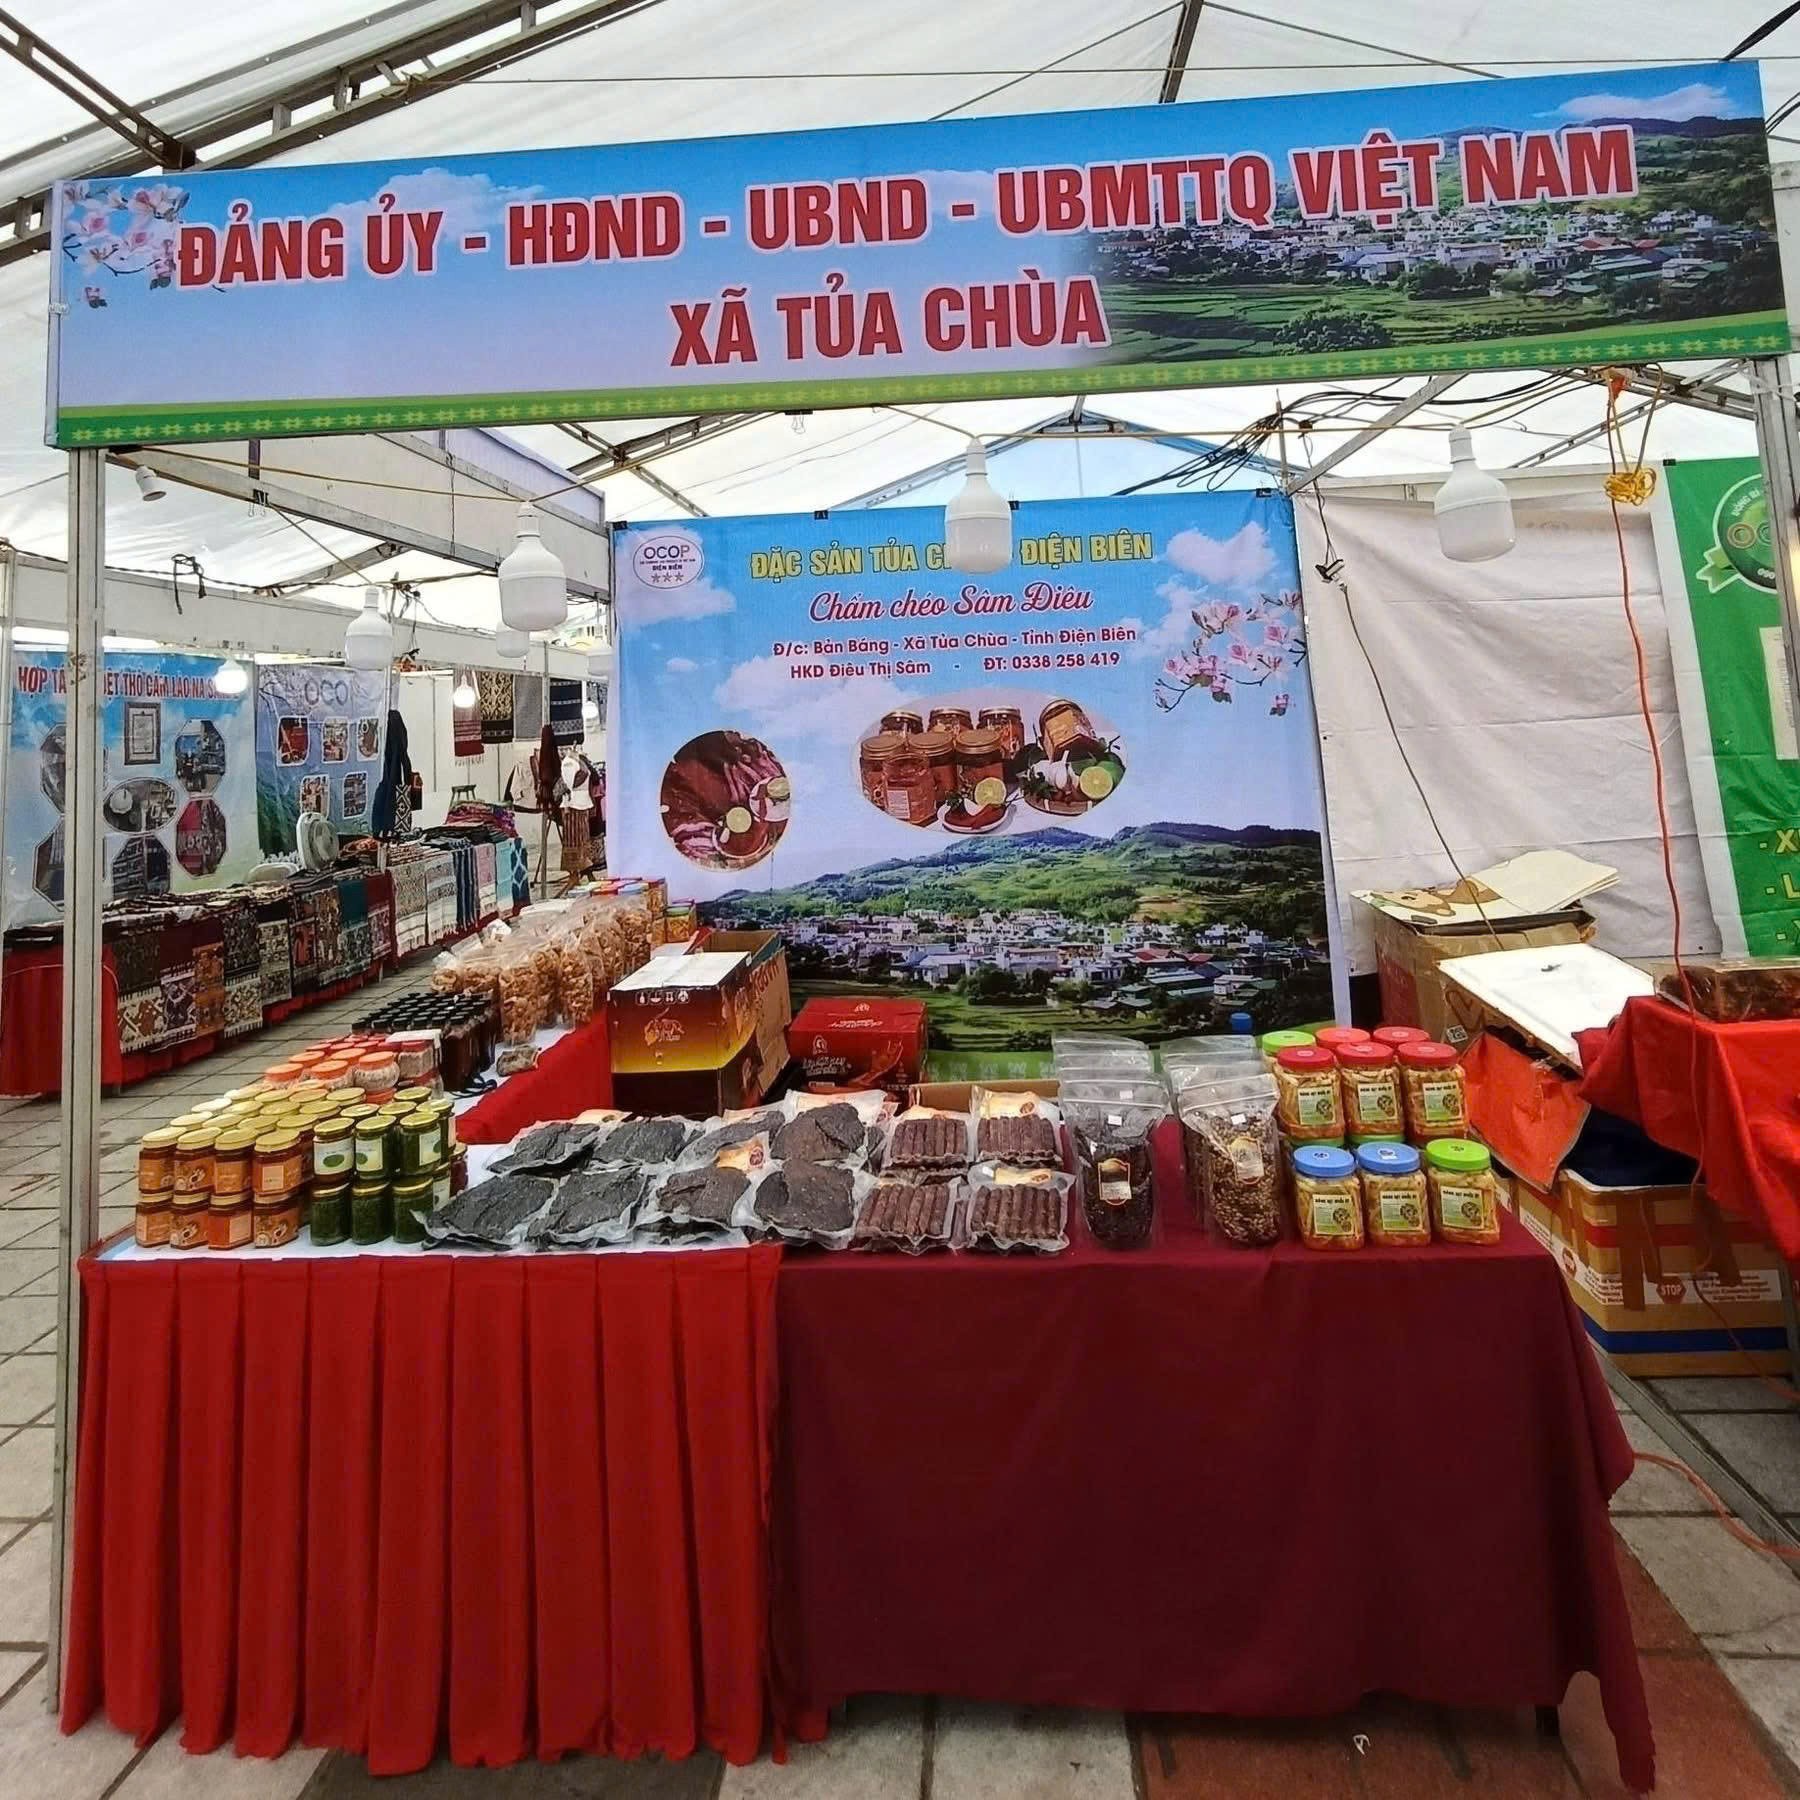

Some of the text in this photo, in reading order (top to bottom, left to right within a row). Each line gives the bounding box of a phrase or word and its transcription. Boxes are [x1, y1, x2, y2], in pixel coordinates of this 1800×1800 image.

[178, 202, 344, 287] ĐẢNG
[366, 193, 444, 275] ỦY
[508, 195, 681, 266] HĐND
[749, 178, 928, 250] UBND
[997, 154, 1273, 234] UBMTTQ
[1292, 132, 1440, 225] VIỆT
[1463, 128, 1634, 204] NAM
[670, 268, 1107, 366] XÃ TỦA CHÙA
[643, 544, 690, 560] OCOP
[750, 545, 803, 583] ĐẶC
[809, 539, 864, 576] SẢN
[868, 536, 920, 573] TỦA
[1019, 531, 1084, 570] ĐIỆN
[1089, 526, 1154, 563] BIÊN
[810, 580, 1094, 622] Chấm chéo Sâm Điêu
[773, 642, 809, 657] Đ/c:
[848, 637, 890, 655] Báng
[903, 636, 926, 651] Xã
[964, 632, 1008, 648] Chùa
[1058, 629, 1096, 647] Điện
[1101, 627, 1137, 642] Biên
[18, 665, 48, 698] HỢP
[51, 663, 67, 694] TÁ
[790, 664, 825, 679] HKD
[829, 662, 865, 678] Điêu
[868, 661, 892, 679] Thị
[895, 659, 931, 675] Sâm
[983, 656, 1007, 671] ĐT:
[1012, 654, 1051, 669] 0338
[1055, 653, 1086, 668] 258
[1090, 651, 1121, 666] 419
[1660, 1283, 1683, 1297] STOP
